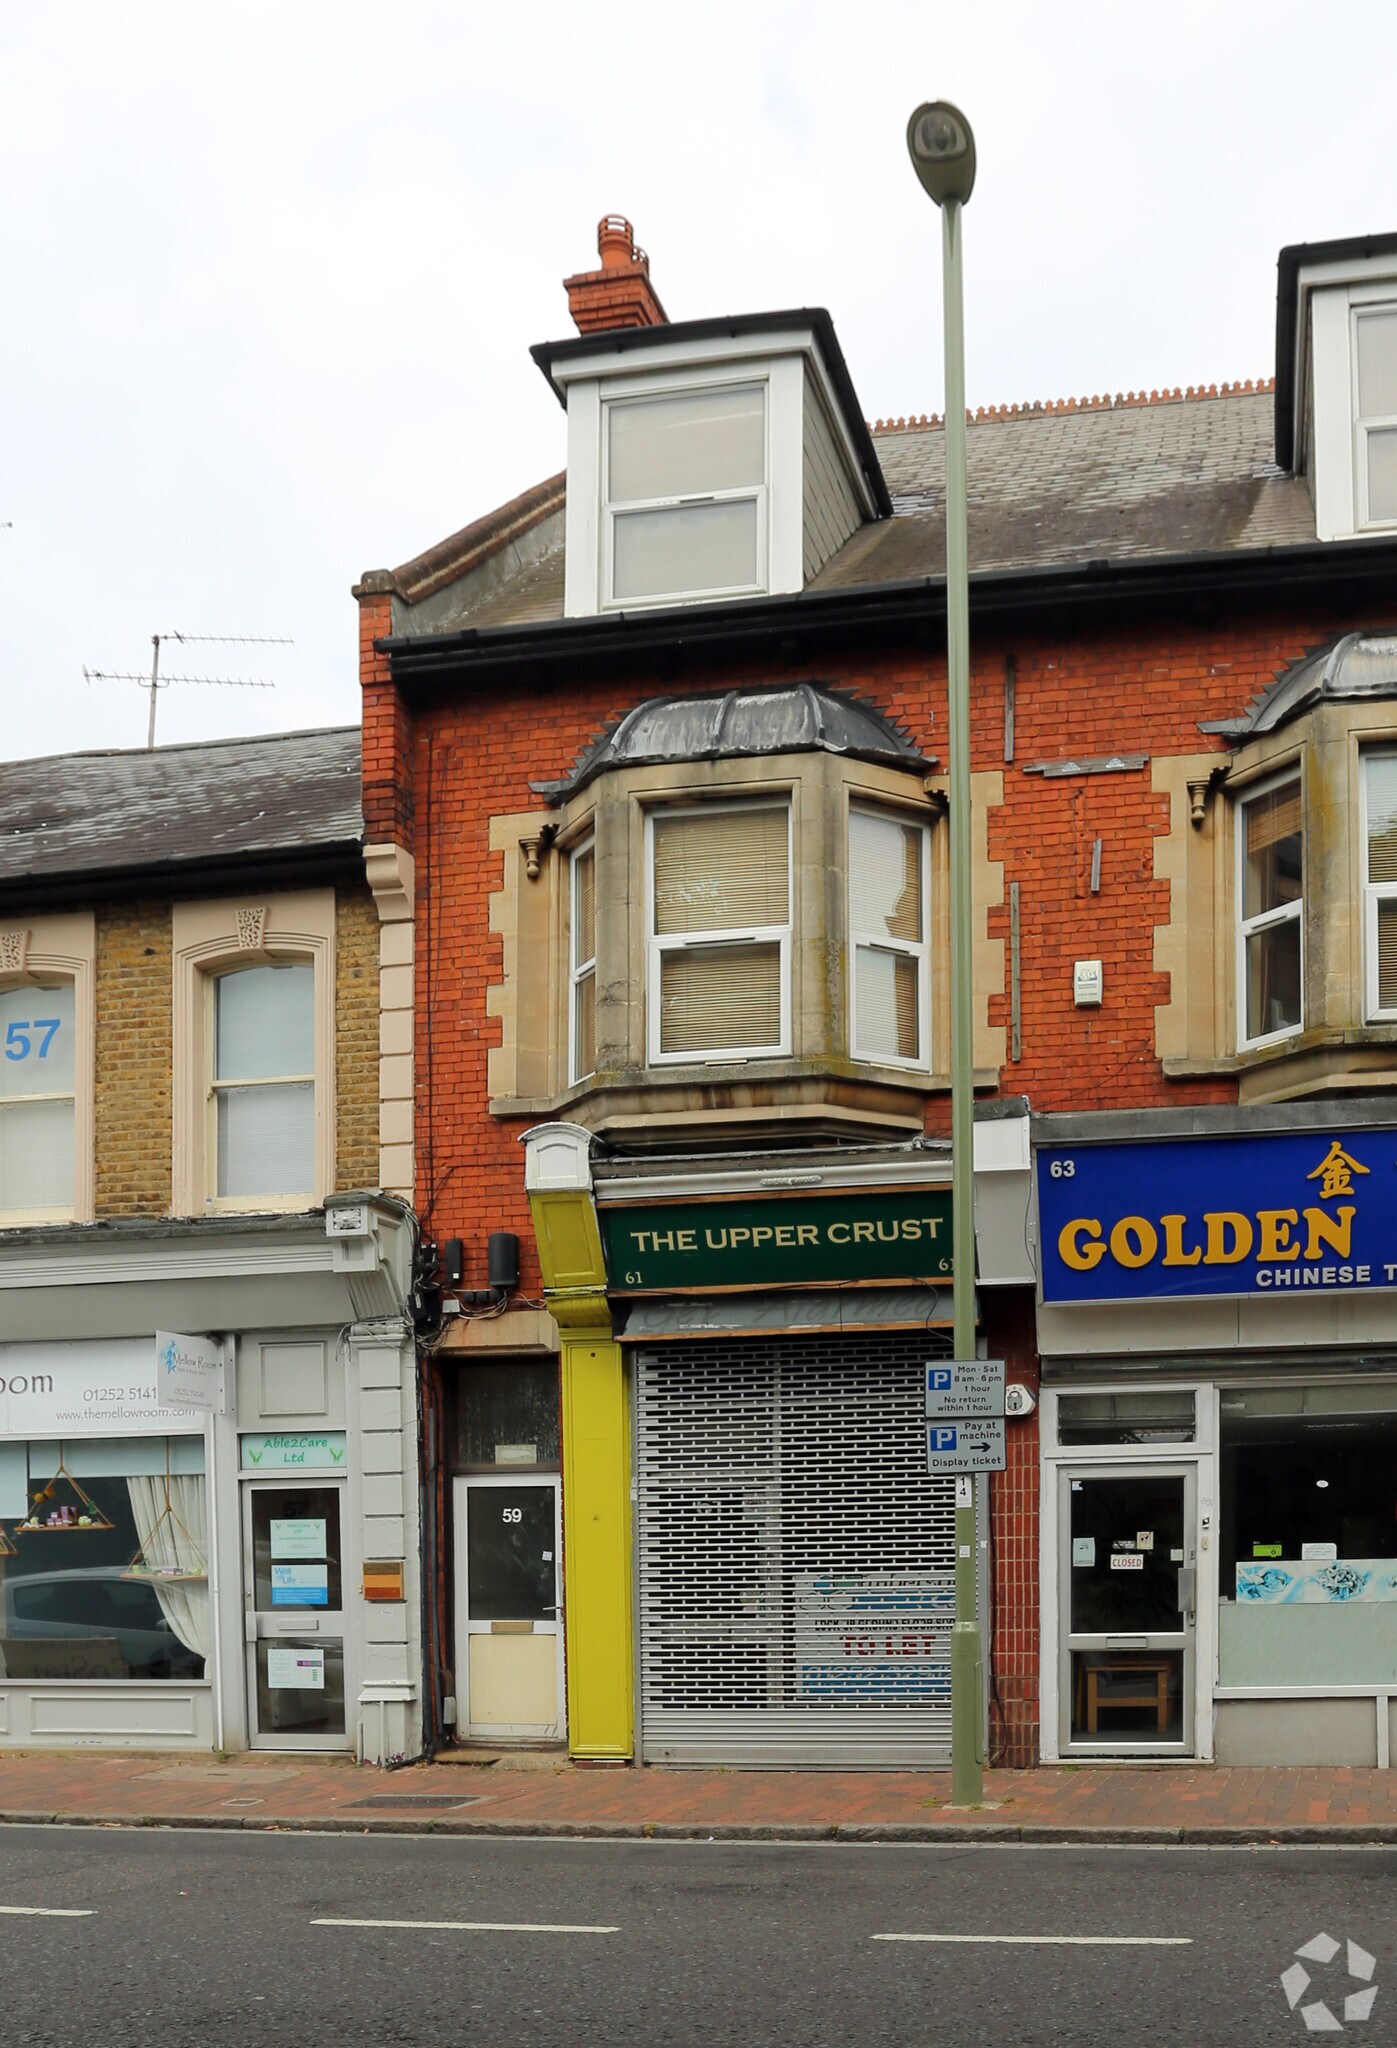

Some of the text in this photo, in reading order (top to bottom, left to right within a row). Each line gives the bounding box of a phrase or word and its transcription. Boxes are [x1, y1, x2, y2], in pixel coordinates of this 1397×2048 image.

[5, 1019, 61, 1061] 57
[1050, 1160, 1075, 1178] 63
[1306, 1141, 1371, 1199] 金
[630, 1217, 944, 1252] THE UPPER CRUST
[1058, 1206, 1356, 1270] GOLDEN
[625, 1271, 644, 1285] 61
[1255, 1265, 1371, 1287] CHINESE
[983, 1365, 998, 1373] Sat
[0, 1374, 53, 1394] om
[83, 1388, 125, 1401] 01252
[944, 1396, 957, 1404] No
[56, 1406, 196, 1421] www.themellowroom.com
[964, 1421, 996, 1431] Pay at
[263, 1436, 328, 1449] Able2Care
[960, 1431, 1001, 1440] machine
[284, 1452, 305, 1463] Ltd
[932, 1456, 1002, 1468] Display ticket
[502, 1508, 523, 1523] 59
[1112, 1558, 1142, 1568] CLOSED
[839, 1635, 937, 1656] TO LET
